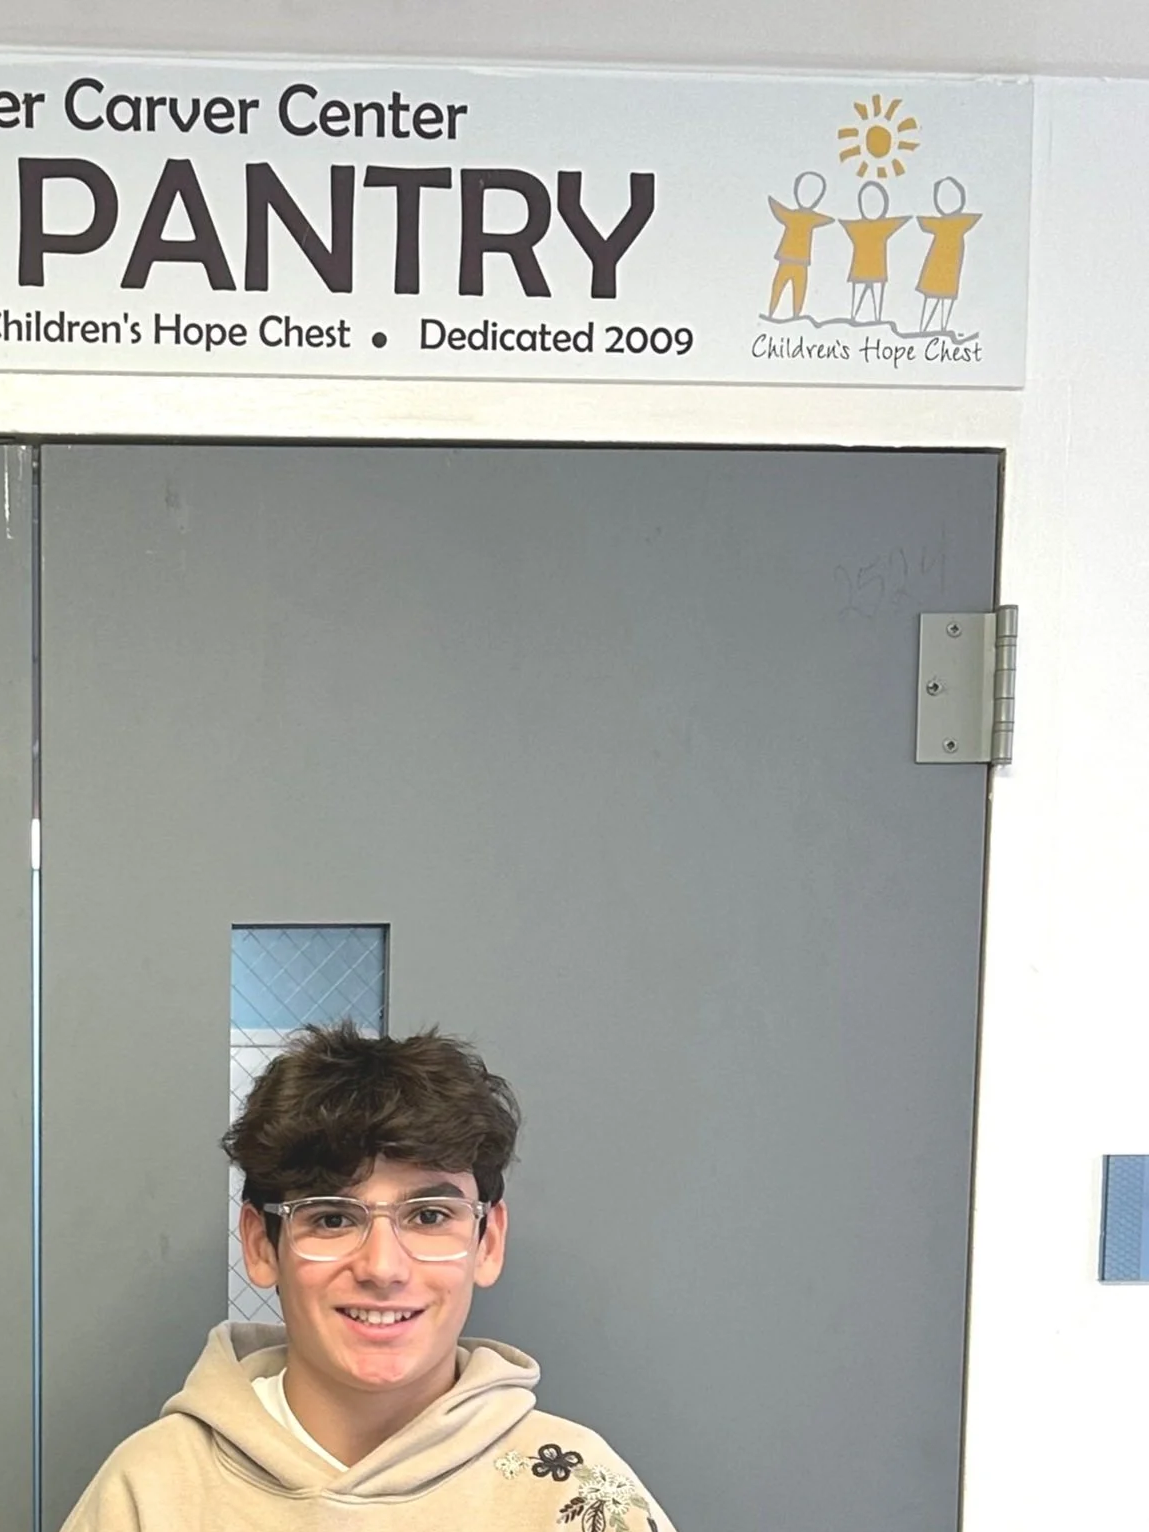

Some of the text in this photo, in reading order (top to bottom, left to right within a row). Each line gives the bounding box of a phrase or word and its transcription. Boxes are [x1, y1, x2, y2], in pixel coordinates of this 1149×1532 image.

[64, 77, 259, 134] Carver
[278, 83, 467, 139] Center
[18, 158, 655, 299] PANTRY
[154, 313, 247, 351] Hope
[259, 314, 350, 347] Chest
[420, 318, 593, 352] Dedicated
[605, 326, 693, 355] 2009
[751, 333, 981, 368] Children's Hope Chest
